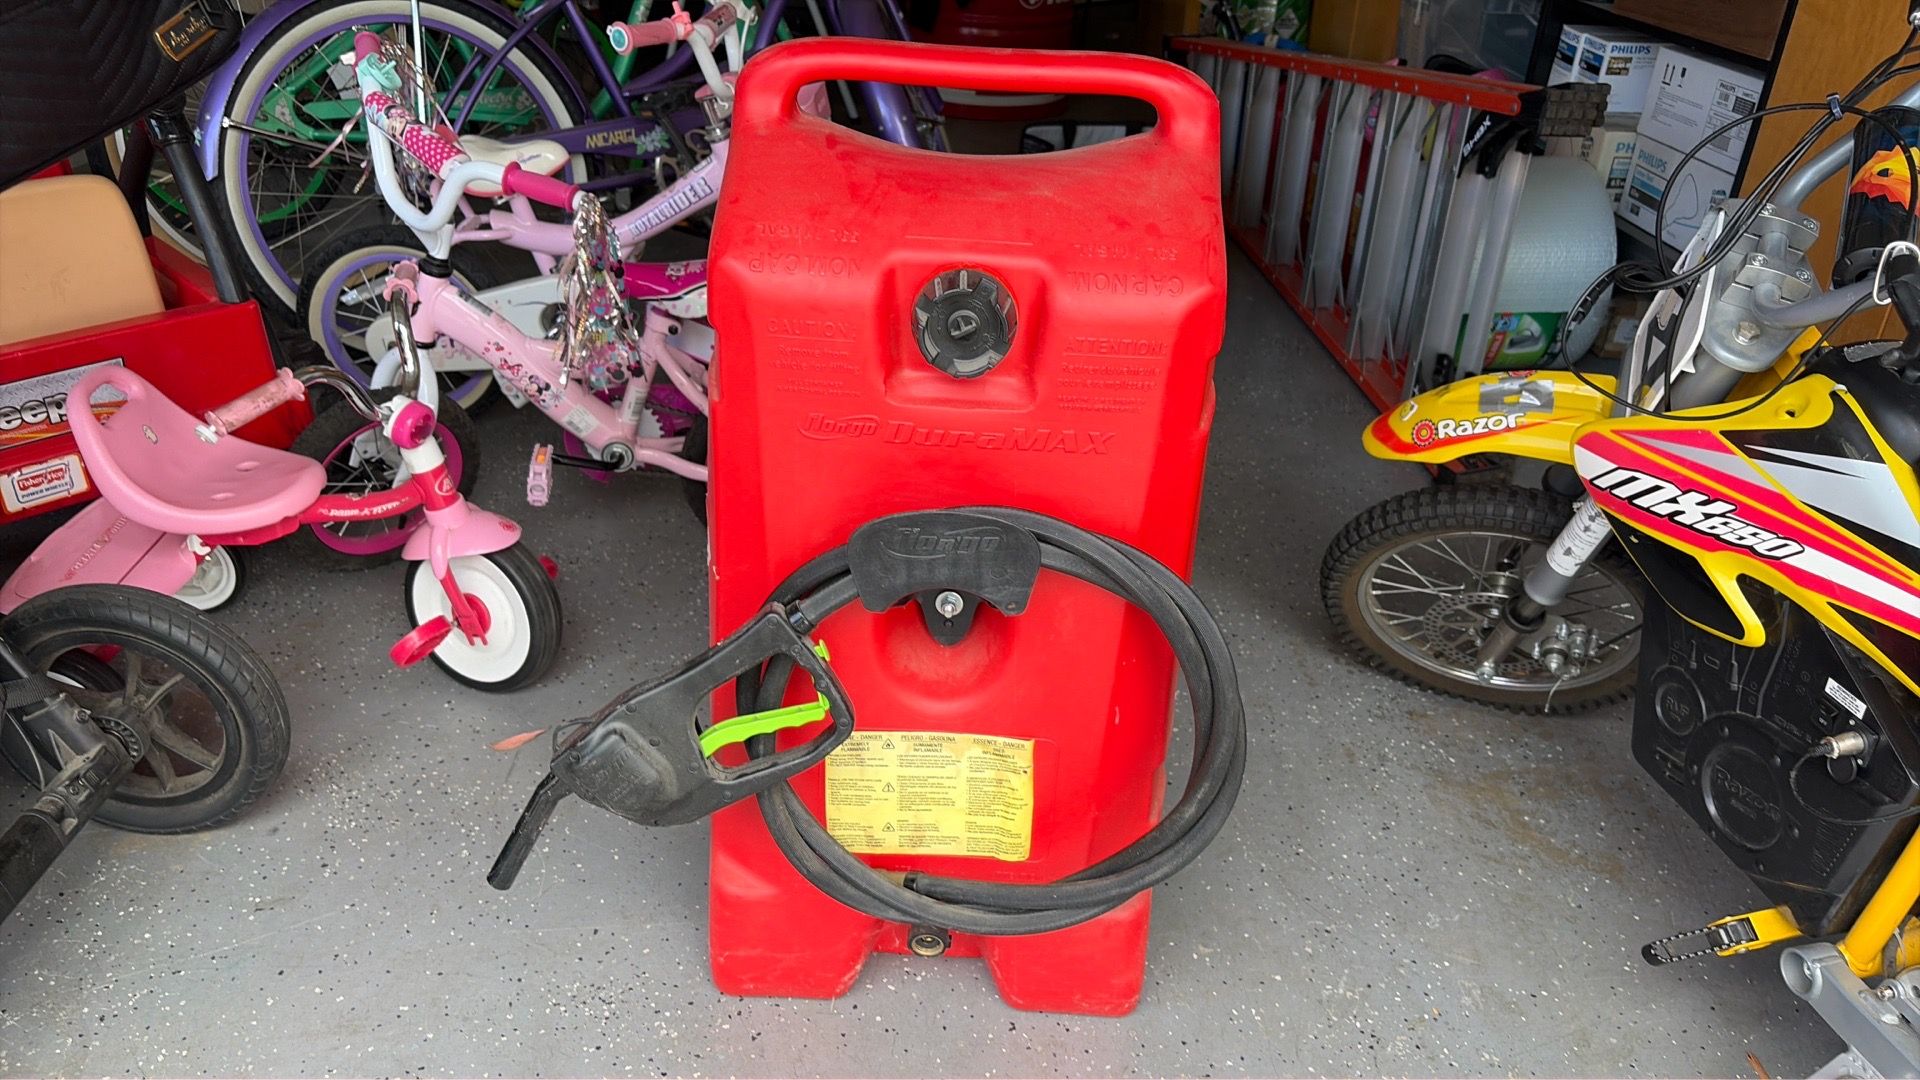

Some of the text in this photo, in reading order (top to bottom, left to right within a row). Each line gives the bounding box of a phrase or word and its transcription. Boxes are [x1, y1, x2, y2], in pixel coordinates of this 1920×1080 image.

[1610, 44, 1652, 55] PHILIPS
[586, 129, 636, 149] MICARGI
[1638, 150, 1668, 173] PHILIPS
[883, 420, 1117, 455] DuraMAX
[1437, 412, 1525, 440] Razor
